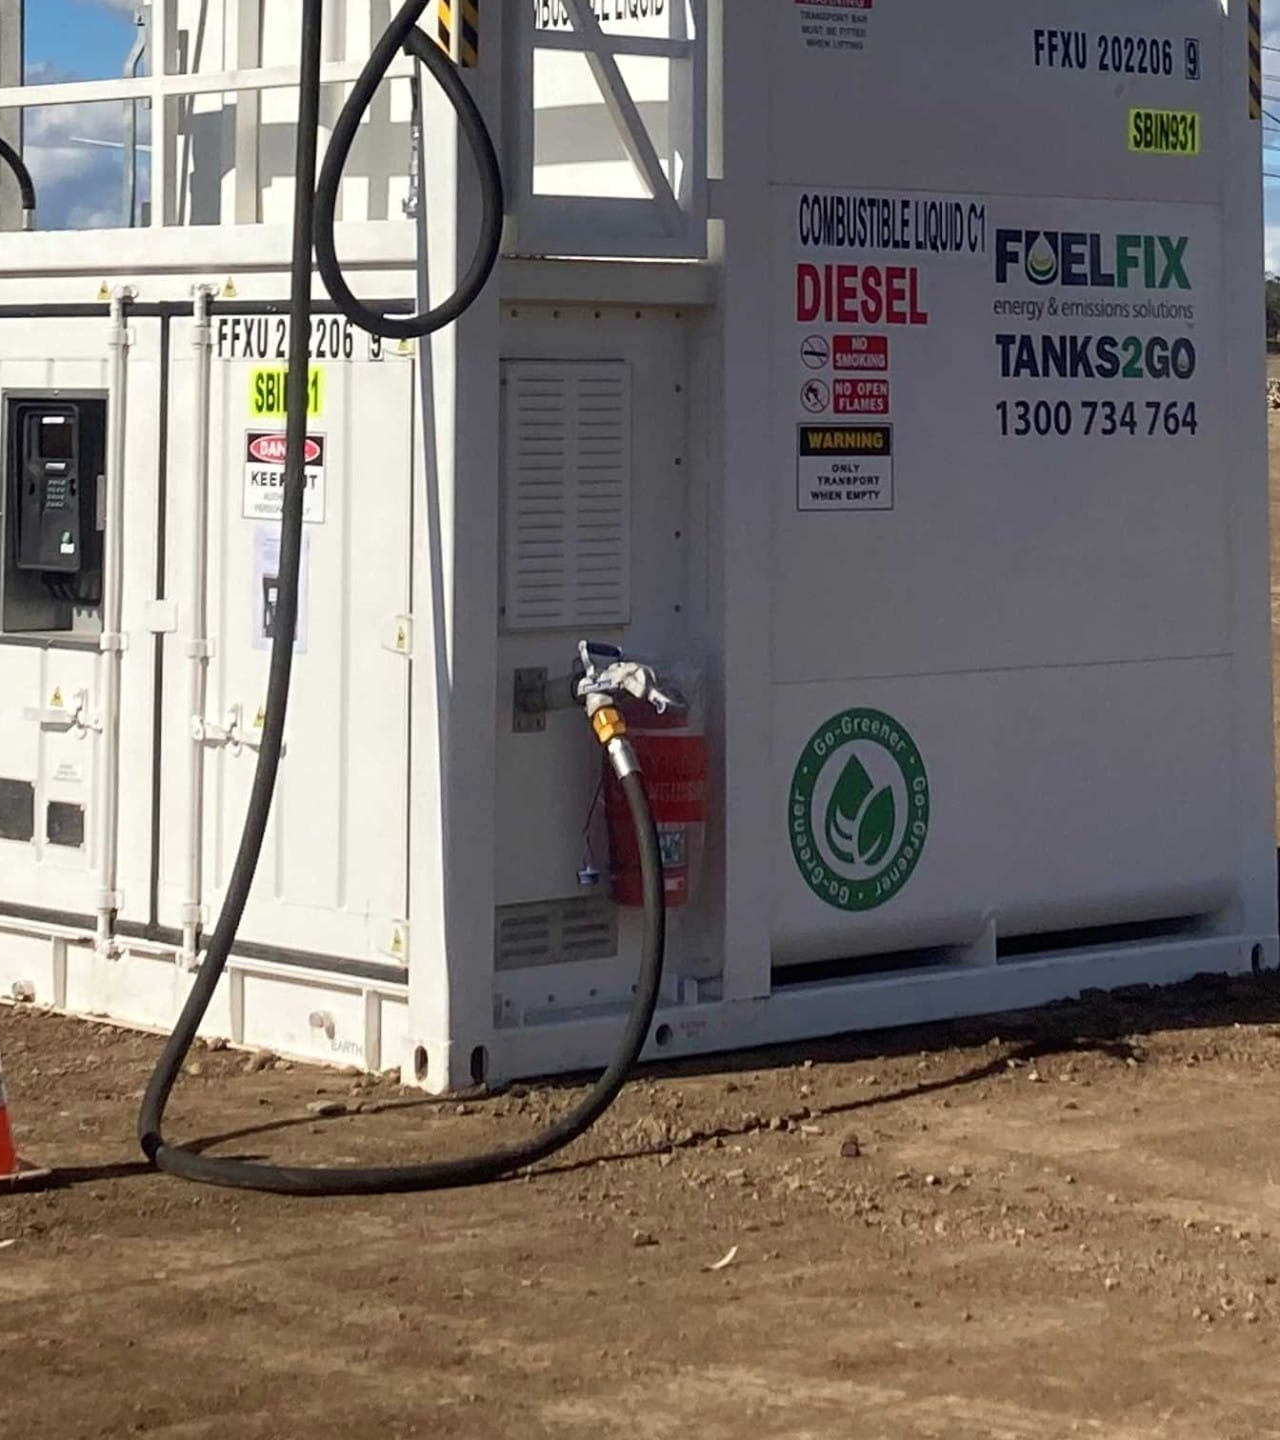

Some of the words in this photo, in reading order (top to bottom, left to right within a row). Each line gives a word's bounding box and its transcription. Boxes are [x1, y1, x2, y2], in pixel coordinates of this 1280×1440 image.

[1034, 29, 1087, 69] FFXU
[1098, 35, 1172, 75] 202206
[1187, 41, 1198, 76] 9
[1133, 111, 1196, 152] SBIN931
[800, 194, 910, 249] COMBUSTIBLE
[915, 201, 964, 253] LIQUID
[967, 203, 985, 253] C1
[995, 229, 1192, 289] FUELFIX
[797, 263, 928, 325] DIESEL
[994, 299, 1045, 320] energy
[1047, 297, 1058, 316] &
[1062, 299, 1129, 318] emissions
[1132, 299, 1194, 319] solutions
[218, 318, 268, 358] FFXU
[851, 337, 868, 350] NO
[995, 334, 1196, 379] TANKS2GO
[835, 353, 886, 368] SMOKING
[835, 382, 852, 395] NO
[857, 382, 888, 396] OPEN
[839, 397, 885, 411] FLAMES
[996, 400, 1072, 436] 1300
[1081, 401, 1137, 436] 734
[1145, 401, 1198, 436] 764
[808, 431, 884, 449] WARNING
[817, 475, 880, 486] TRANSPORT
[831, 463, 860, 474] ONLY
[810, 490, 842, 501] WHEN
[846, 490, 881, 501] EMPTY
[813, 716, 909, 755] Go-Greener
[793, 788, 850, 904] Go-Greener
[875, 776, 927, 897] Go-Greener
